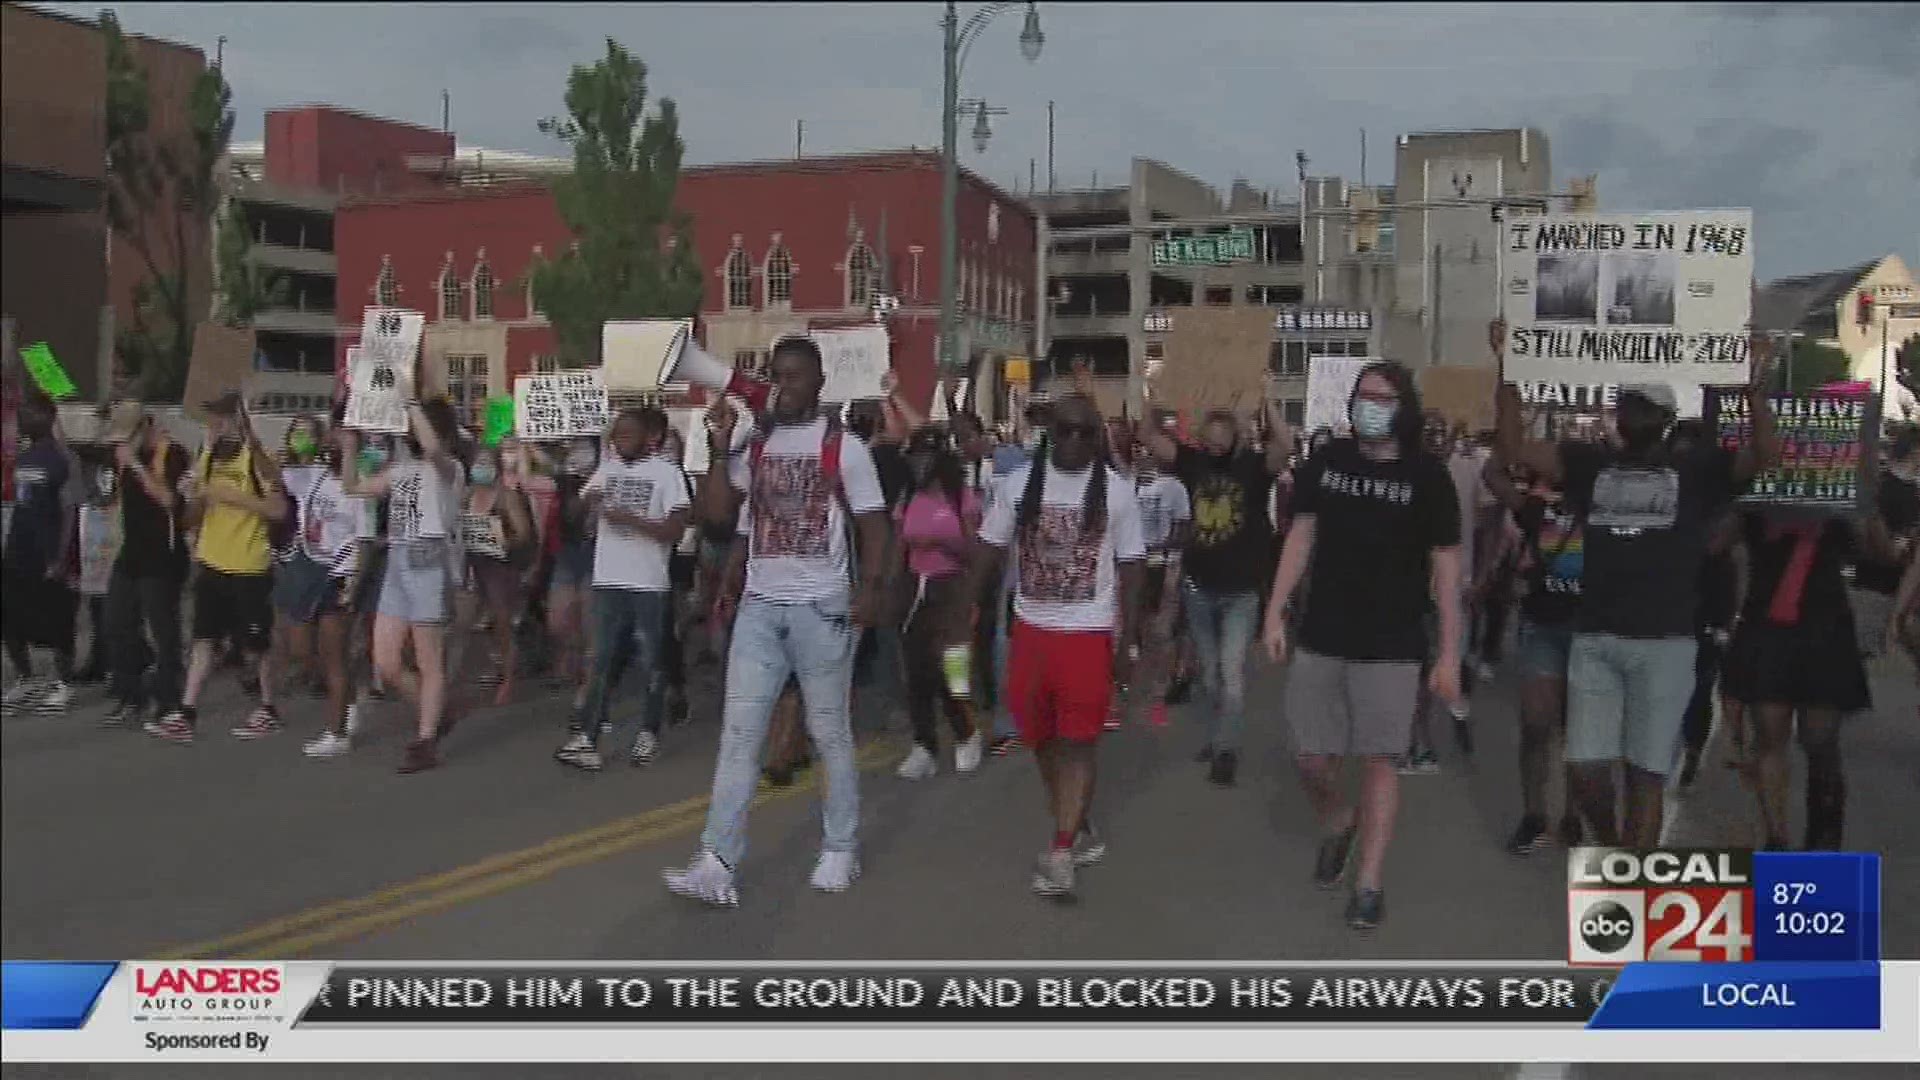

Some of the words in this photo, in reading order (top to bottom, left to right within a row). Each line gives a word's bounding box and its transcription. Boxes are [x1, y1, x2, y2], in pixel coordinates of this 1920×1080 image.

[1510, 223, 1531, 252] I
[1535, 222, 1625, 254] MARCHED
[1632, 222, 1674, 251] IN
[1684, 222, 1747, 256] 1968
[1510, 328, 1575, 358] STILL
[1577, 330, 1685, 365] MARCHING
[1516, 383, 1619, 405] MATTE
